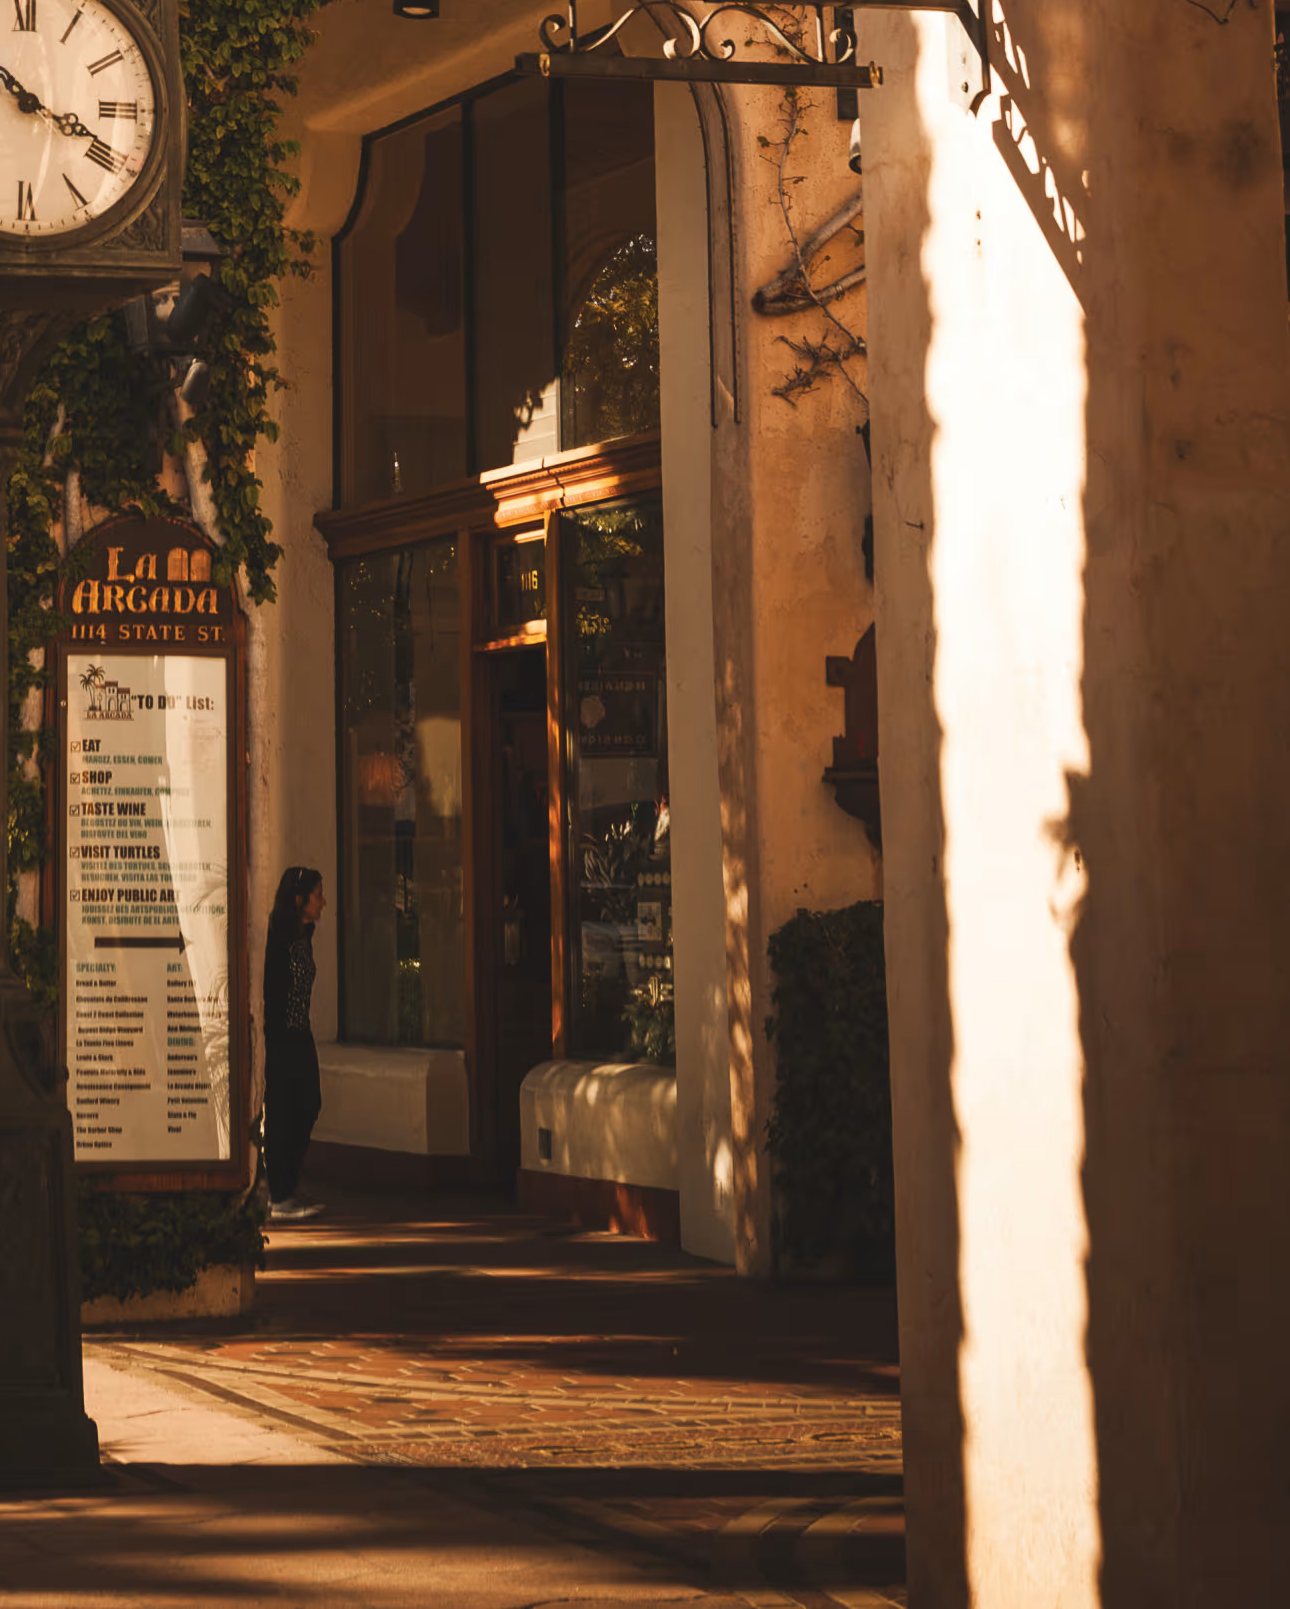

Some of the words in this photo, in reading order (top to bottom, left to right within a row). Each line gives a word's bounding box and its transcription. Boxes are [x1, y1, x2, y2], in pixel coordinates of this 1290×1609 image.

[86, 48, 124, 78] II
[98, 99, 137, 123] III
[521, 570, 538, 591] 1116
[71, 623, 106, 639] 1114
[119, 623, 185, 641] STATE
[198, 625, 226, 642] ST.
[86, 711, 98, 720] LA
[99, 711, 133, 720] ARCADA
[82, 739, 101, 753] EAT
[82, 771, 113, 784] SHOP
[81, 802, 115, 816] TASTE
[117, 802, 146, 816] WINE
[81, 845, 110, 859] VISIT
[113, 845, 161, 859] TURTLES
[82, 889, 115, 903] ENJOY
[117, 889, 158, 902] PUBLIC
